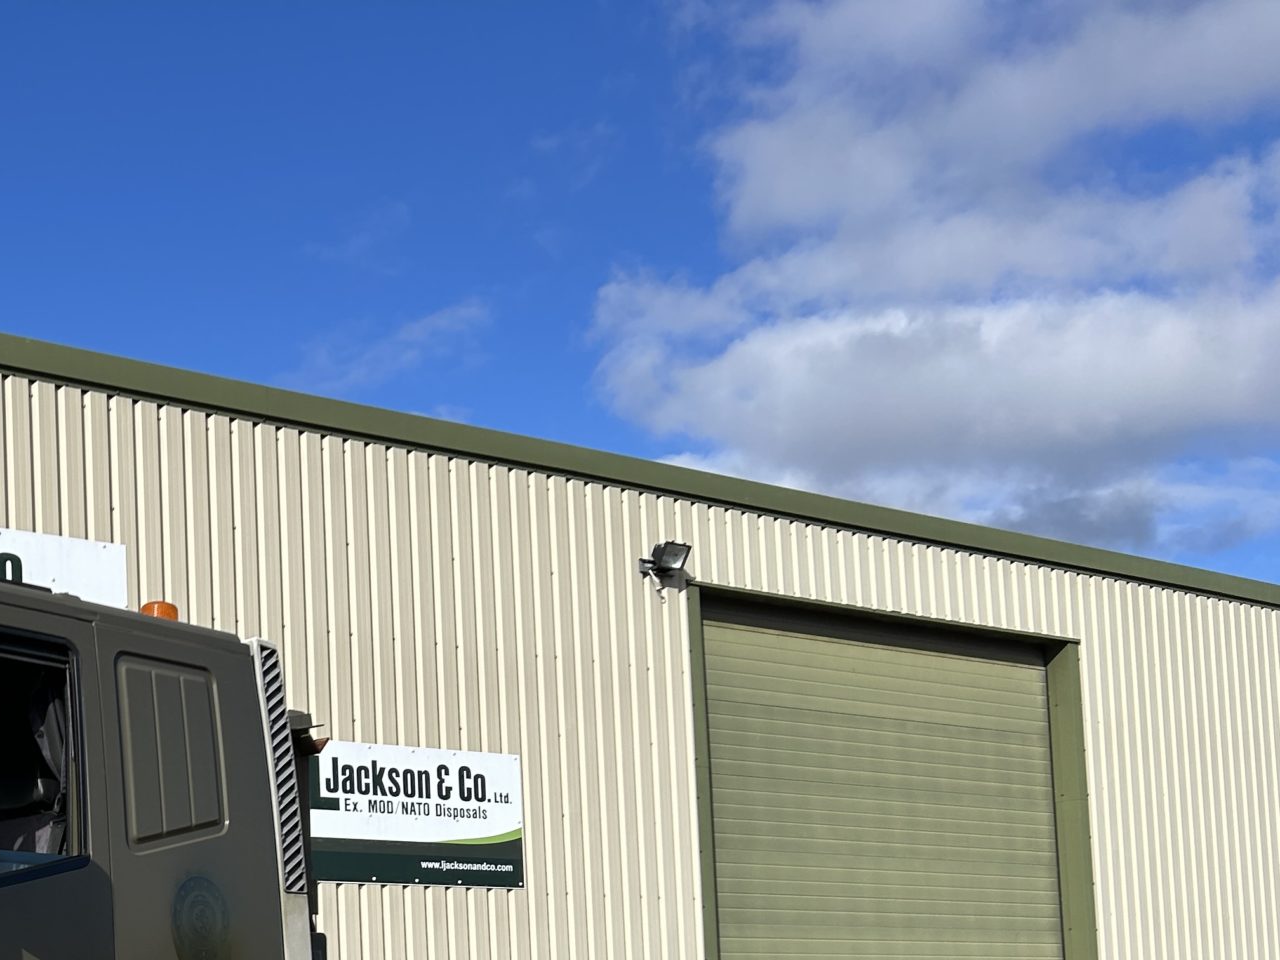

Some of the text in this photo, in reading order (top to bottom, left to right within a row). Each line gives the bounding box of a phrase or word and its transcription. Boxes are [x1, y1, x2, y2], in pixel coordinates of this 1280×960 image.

[436, 764, 453, 801] &
[458, 765, 492, 803] Co.
[493, 791, 513, 805] Ltd.
[344, 797, 488, 821] Ex. MOD/NATO Disposals
[420, 859, 514, 873] www.ljacksonandco.com
